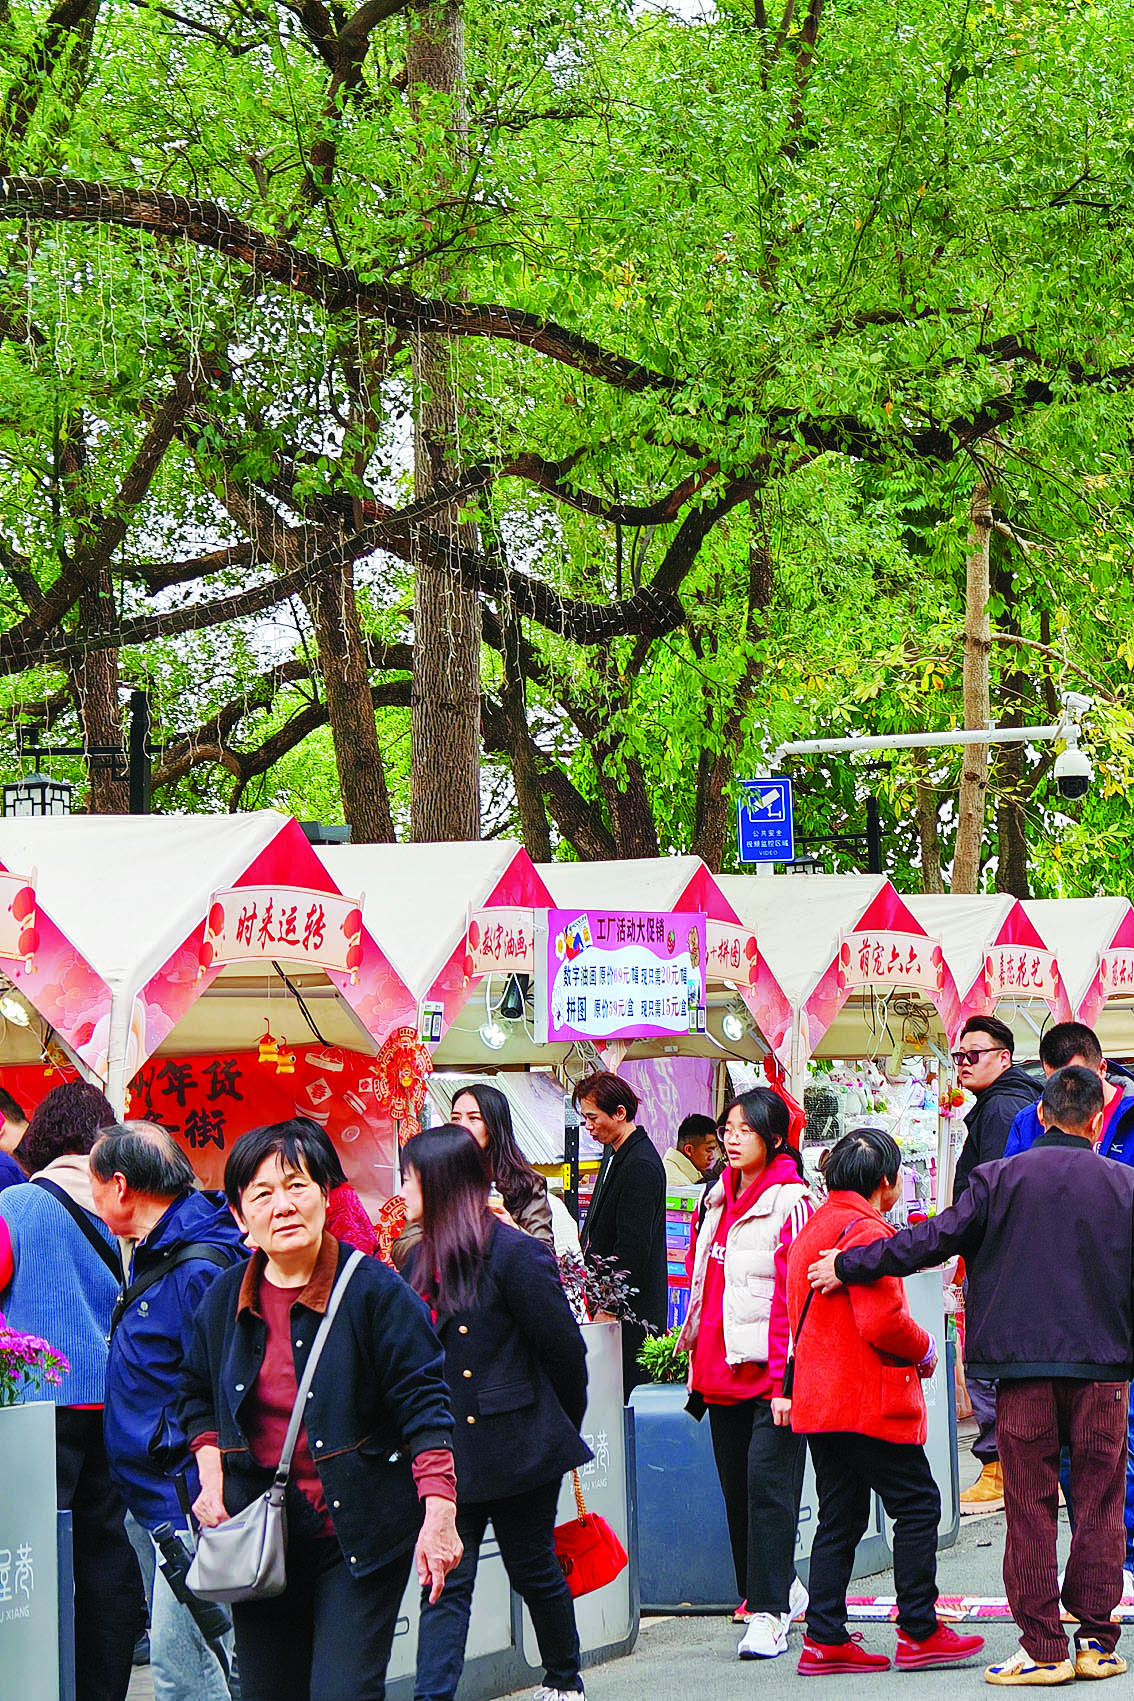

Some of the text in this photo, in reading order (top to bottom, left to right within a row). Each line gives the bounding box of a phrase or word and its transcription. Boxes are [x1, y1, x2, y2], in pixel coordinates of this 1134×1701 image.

[753, 829, 783, 837] 公共安全
[236, 897, 326, 951] 时来运转
[597, 917, 665, 943] 工厂活动大促销
[858, 937, 921, 977] 萌宠六六
[563, 965, 597, 987] 数字油画
[566, 996, 587, 1023] 拼图
